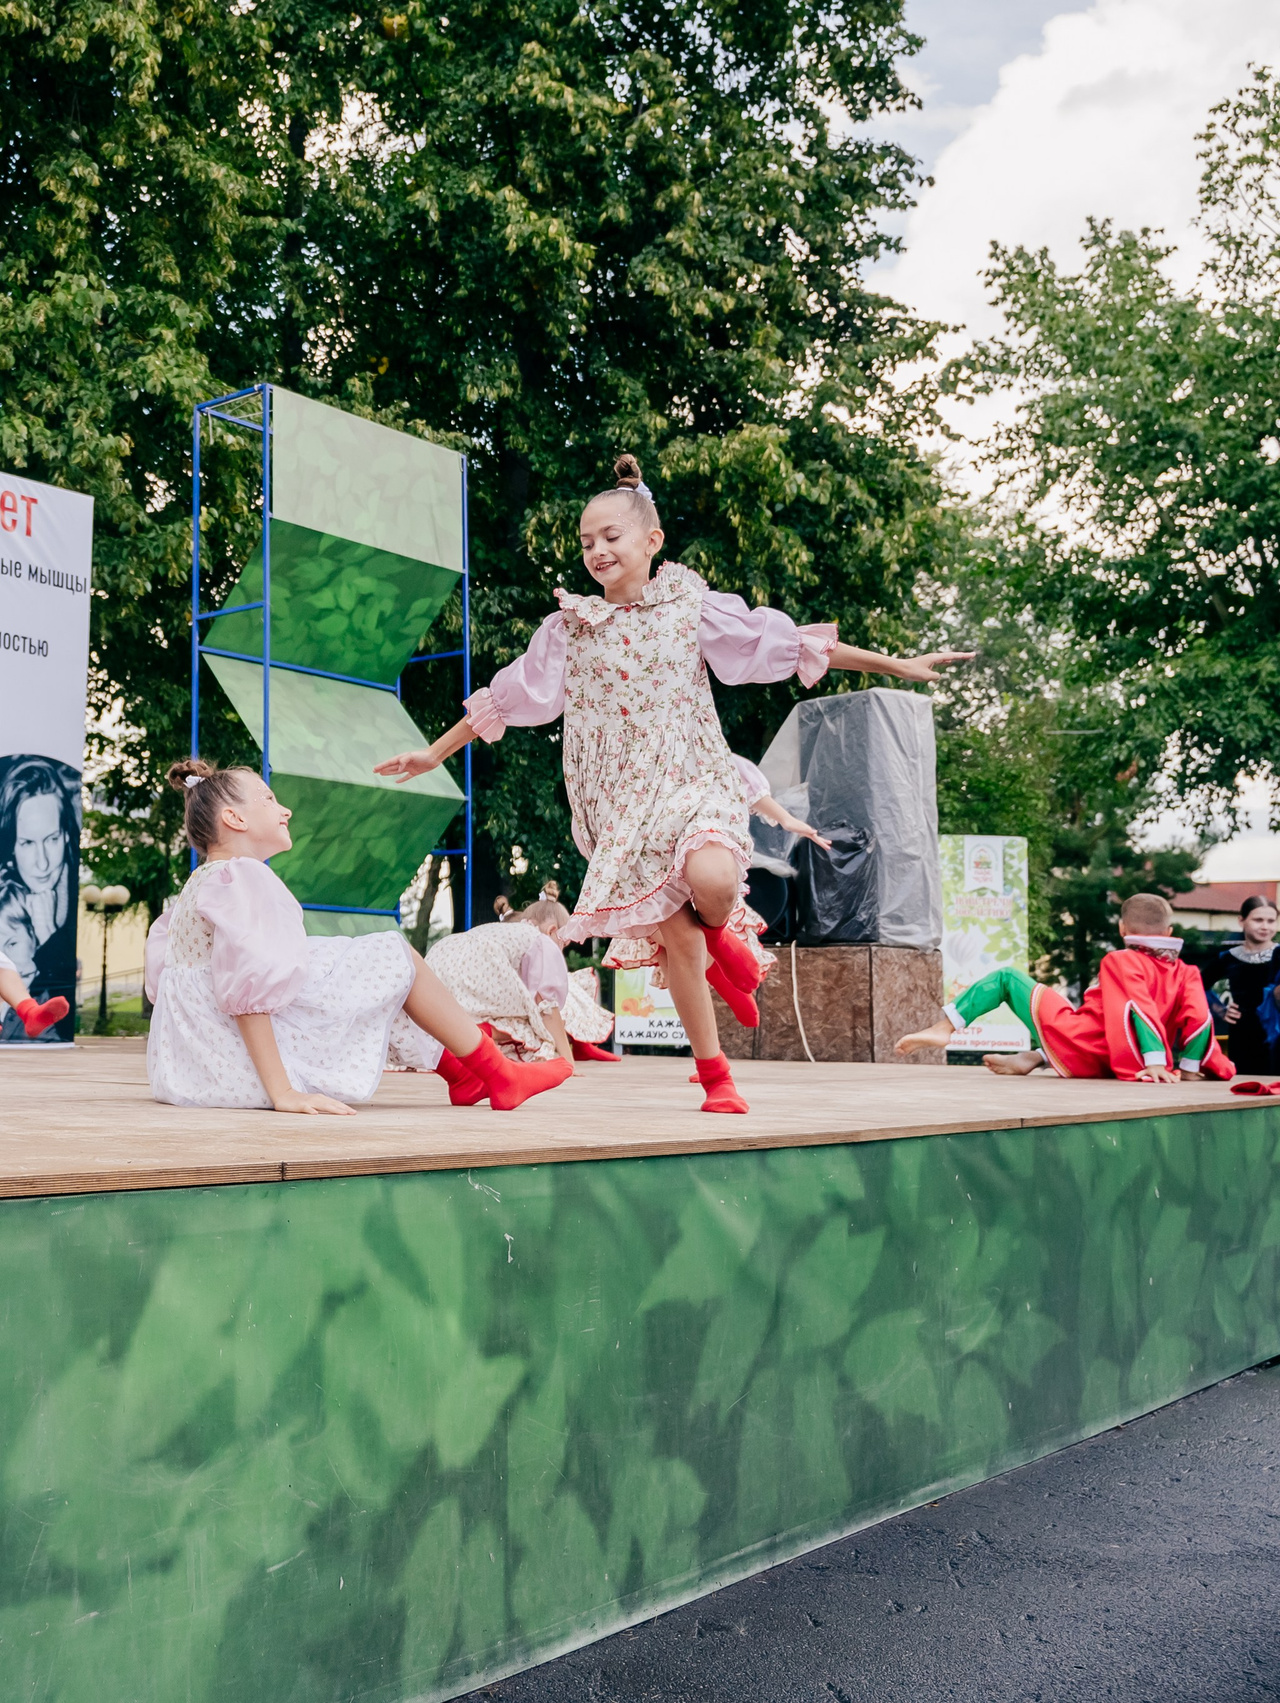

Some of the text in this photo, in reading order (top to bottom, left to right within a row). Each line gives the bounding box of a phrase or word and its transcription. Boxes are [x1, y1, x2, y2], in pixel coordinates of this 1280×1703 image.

[28, 562, 88, 596] мышцы
[648, 1019, 683, 1029] КАЖД
[619, 1030, 689, 1040] КАЖДУЮ СУ
[955, 1027, 983, 1036] ЕСТР
